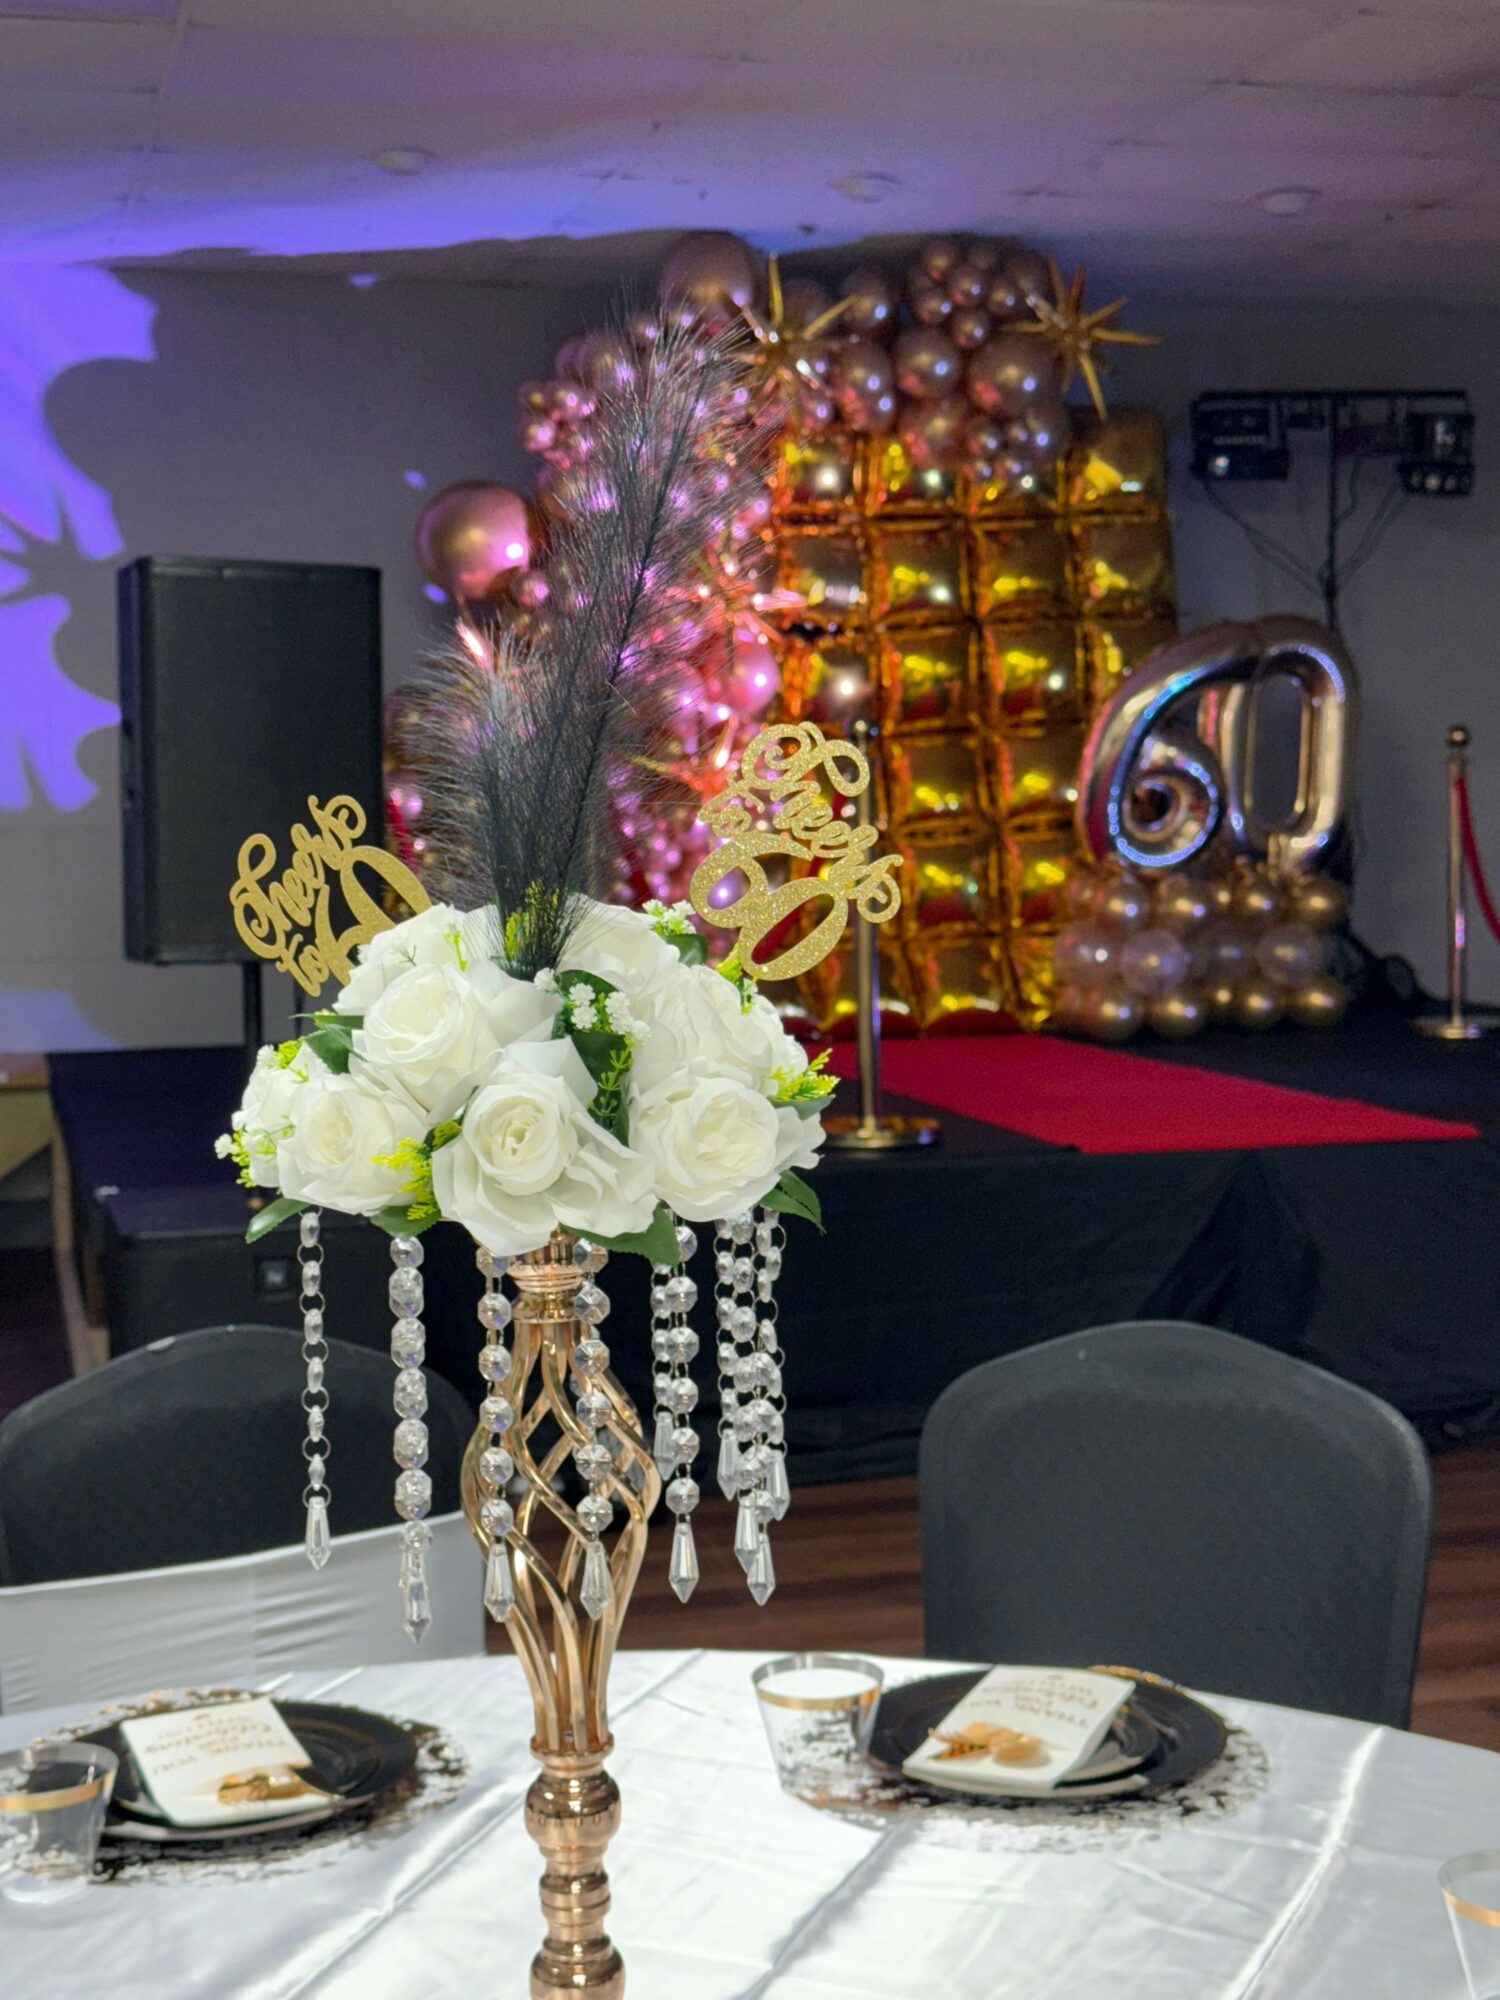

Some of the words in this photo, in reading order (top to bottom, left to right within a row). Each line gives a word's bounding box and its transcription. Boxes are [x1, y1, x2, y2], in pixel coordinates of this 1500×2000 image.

[697, 771, 765, 838] to
[1077, 613, 1360, 867] 60
[229, 795, 366, 959] Cheers
[741, 721, 904, 923] Cheers
[275, 934, 329, 997] to
[690, 833, 849, 980] 60
